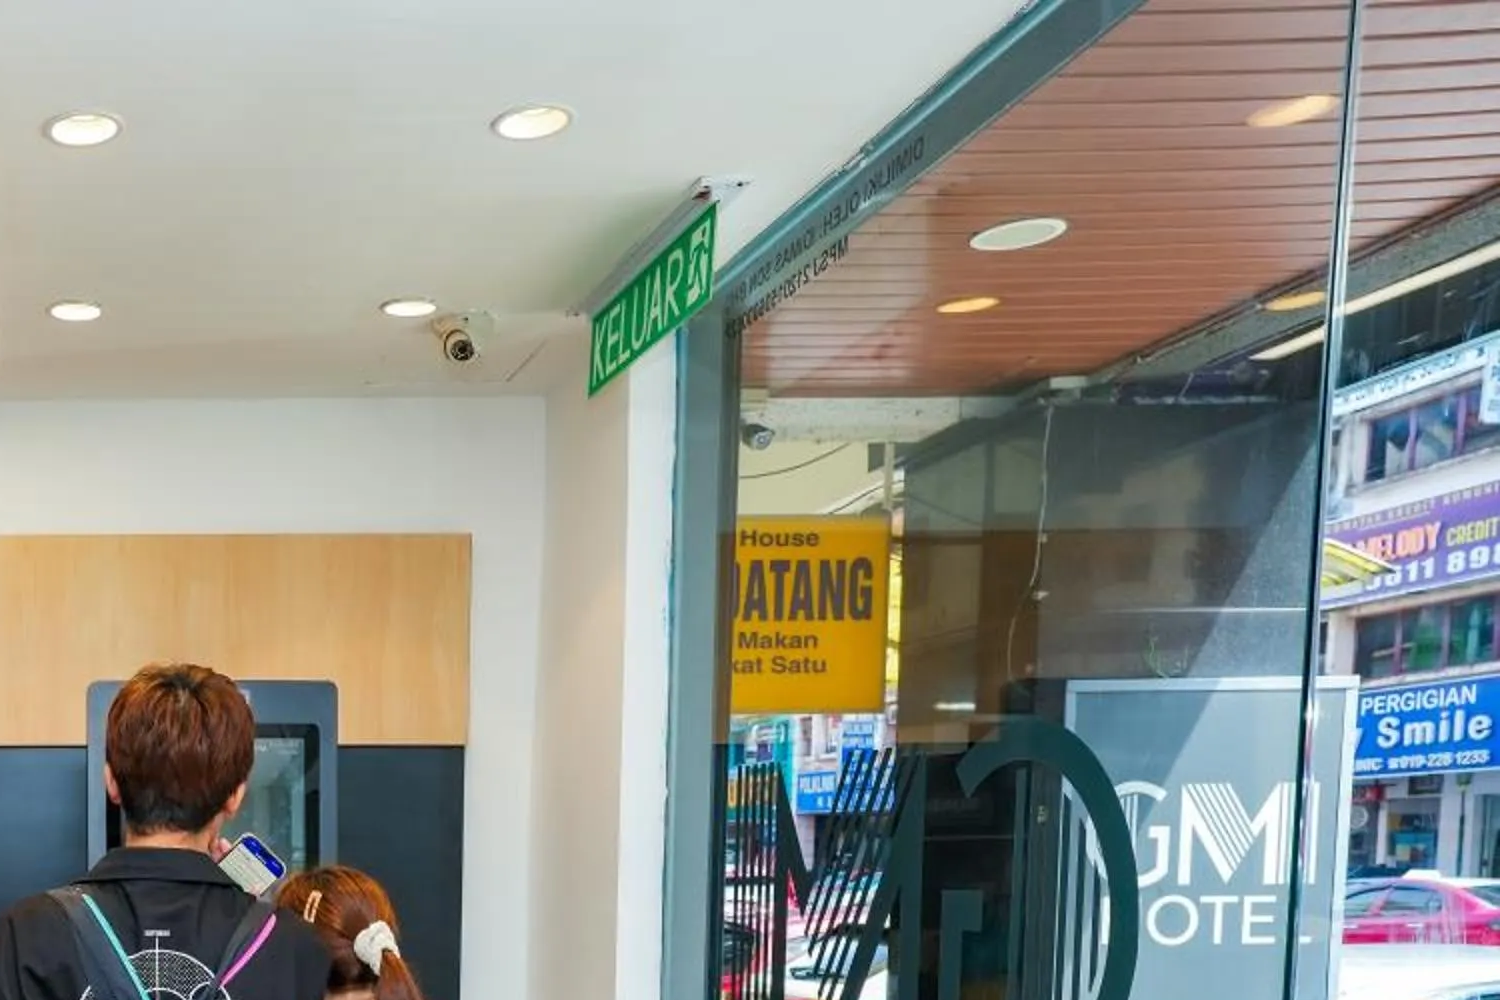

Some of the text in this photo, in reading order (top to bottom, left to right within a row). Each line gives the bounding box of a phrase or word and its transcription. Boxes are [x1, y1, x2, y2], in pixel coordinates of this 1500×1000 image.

[592, 247, 684, 389] KELUAR
[739, 529, 821, 548] House
[1446, 516, 1499, 546] CREDIT
[738, 631, 820, 650] Makan
[771, 656, 828, 675] Satu
[1360, 683, 1477, 717] PERGIGIAN
[1376, 708, 1493, 749] Smile
